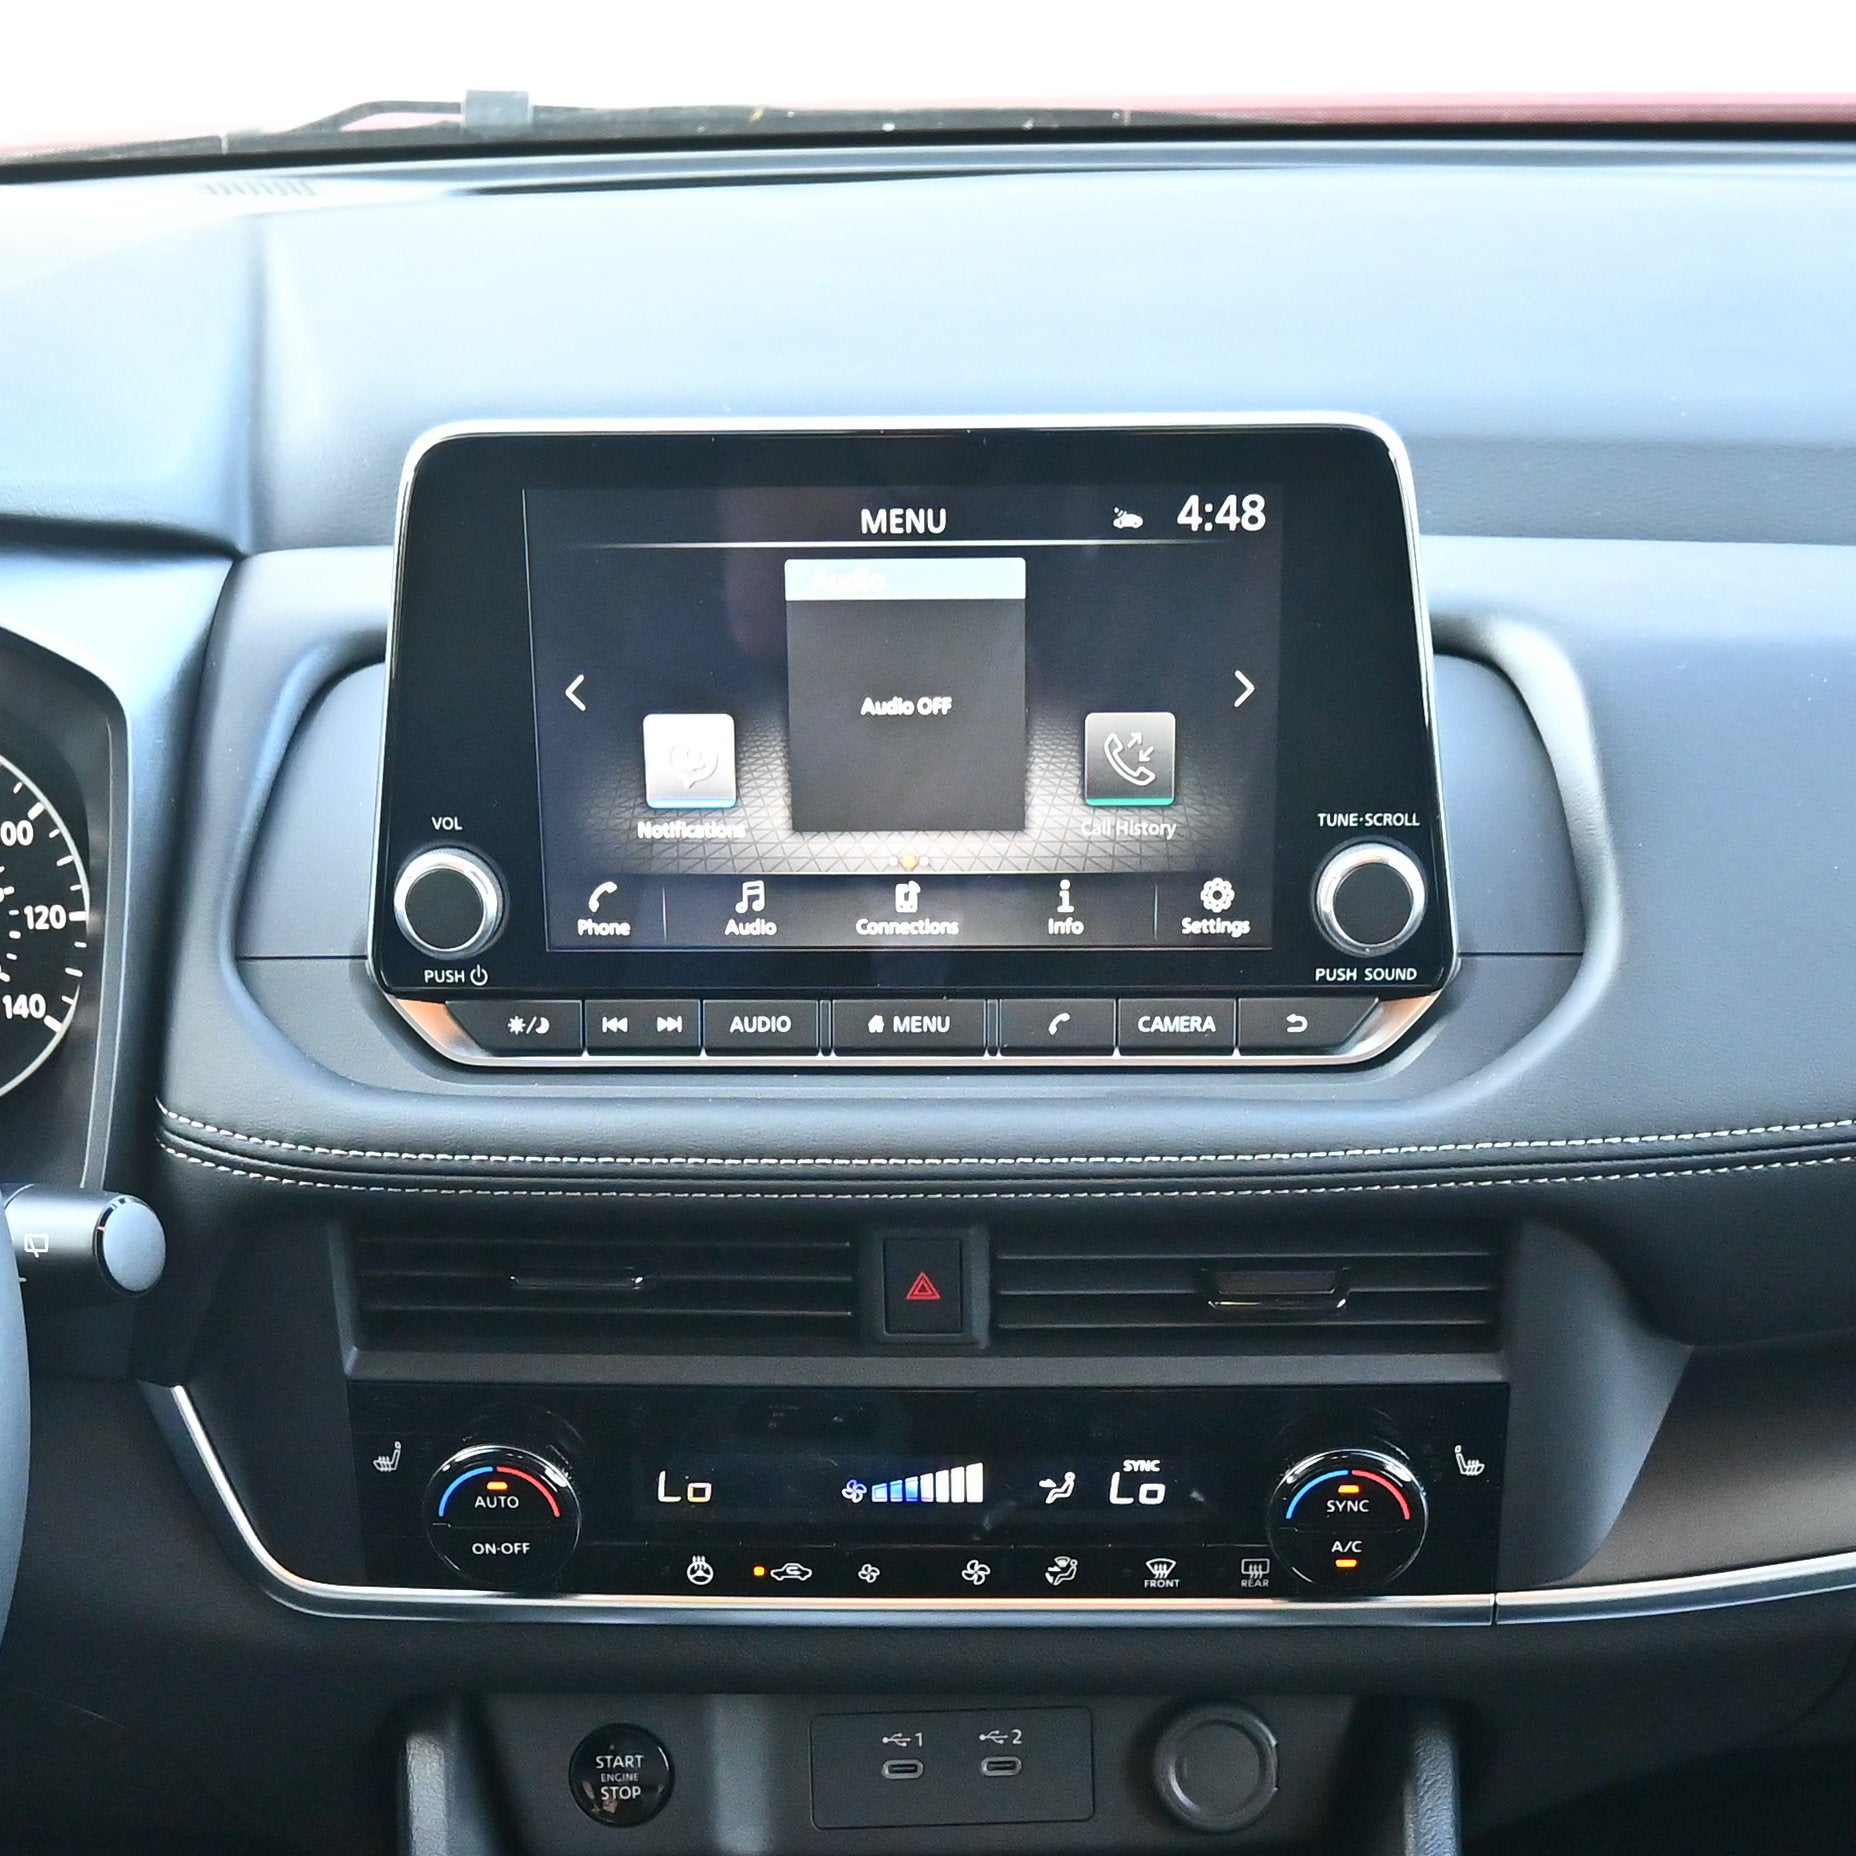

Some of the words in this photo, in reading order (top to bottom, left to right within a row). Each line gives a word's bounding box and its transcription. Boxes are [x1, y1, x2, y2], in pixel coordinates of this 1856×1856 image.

[861, 508, 947, 535] MENU
[1177, 495, 1266, 532] 4:48
[861, 697, 914, 716] Audio
[917, 697, 953, 716] OFF
[432, 816, 462, 831] VOL
[638, 821, 745, 840] Notifications
[1080, 821, 1111, 838] Call
[1114, 820, 1177, 842] History
[24, 905, 66, 930] 120
[578, 919, 631, 937] Phone
[725, 918, 777, 937] Audio
[856, 918, 959, 937] Connections
[1048, 917, 1084, 936] Info
[1181, 917, 1251, 939] Settings
[425, 969, 465, 984] PUSH
[1315, 967, 1357, 982] PUSH
[1364, 967, 1417, 982] SOUND
[2, 993, 46, 1019] 140
[729, 1016, 792, 1033] AUDIO
[893, 1015, 950, 1033] MENU
[1138, 1015, 1217, 1033] CAMERA
[1123, 1459, 1161, 1472] SYNC
[474, 1495, 520, 1509] AUTO
[1326, 1498, 1370, 1514] SYNC
[1331, 1540, 1363, 1554] A/C
[1144, 1578, 1180, 1588] FRONT
[1240, 1577, 1270, 1588] REAR
[915, 1732, 924, 1748] 1
[1013, 1729, 1023, 1745] 2
[595, 1755, 644, 1769] START
[600, 1773, 639, 1783] ENGINE
[600, 1786, 642, 1801] STOP
